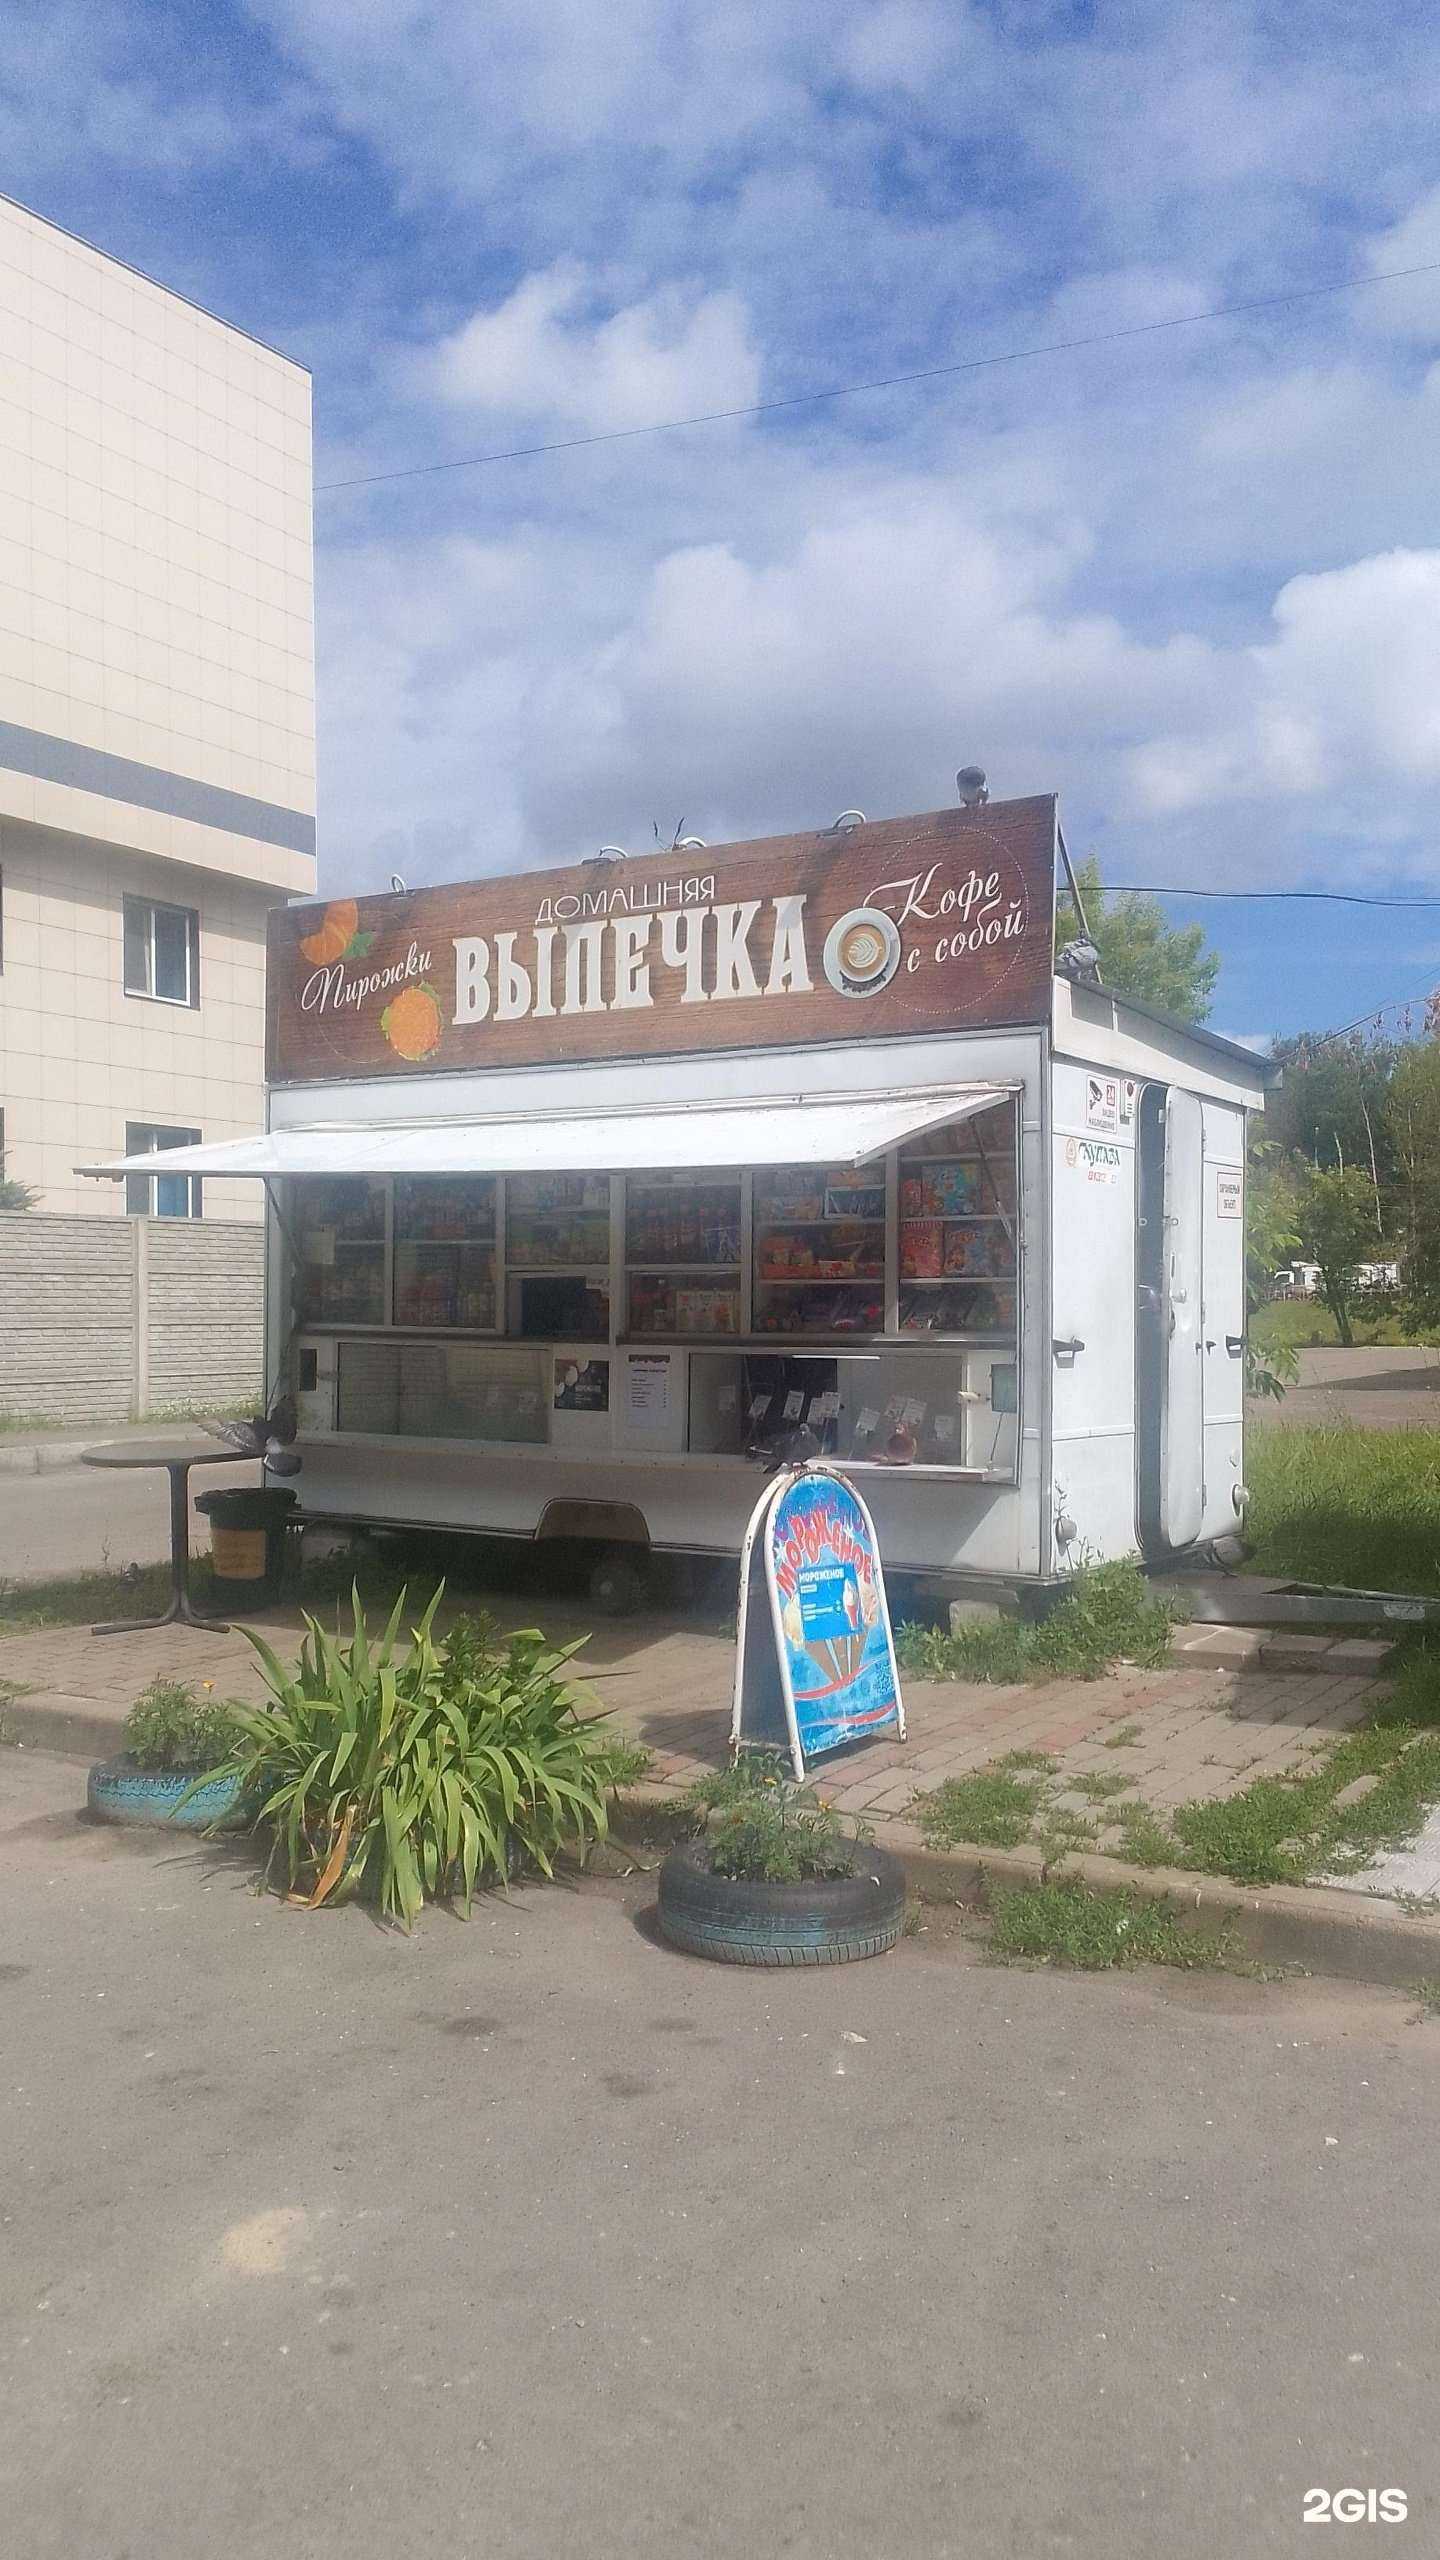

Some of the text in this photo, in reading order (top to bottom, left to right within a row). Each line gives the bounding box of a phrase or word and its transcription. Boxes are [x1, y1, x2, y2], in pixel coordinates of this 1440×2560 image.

[535, 875, 716, 926] ДОМАШНЯЯ
[863, 862, 1001, 926] Кофе
[907, 892, 1024, 973] с собой
[301, 940, 432, 1014] Пирожки
[451, 893, 815, 1026] ВЫПЕЧКА
[775, 1508, 873, 1601] МОРОЖЕНОЕ
